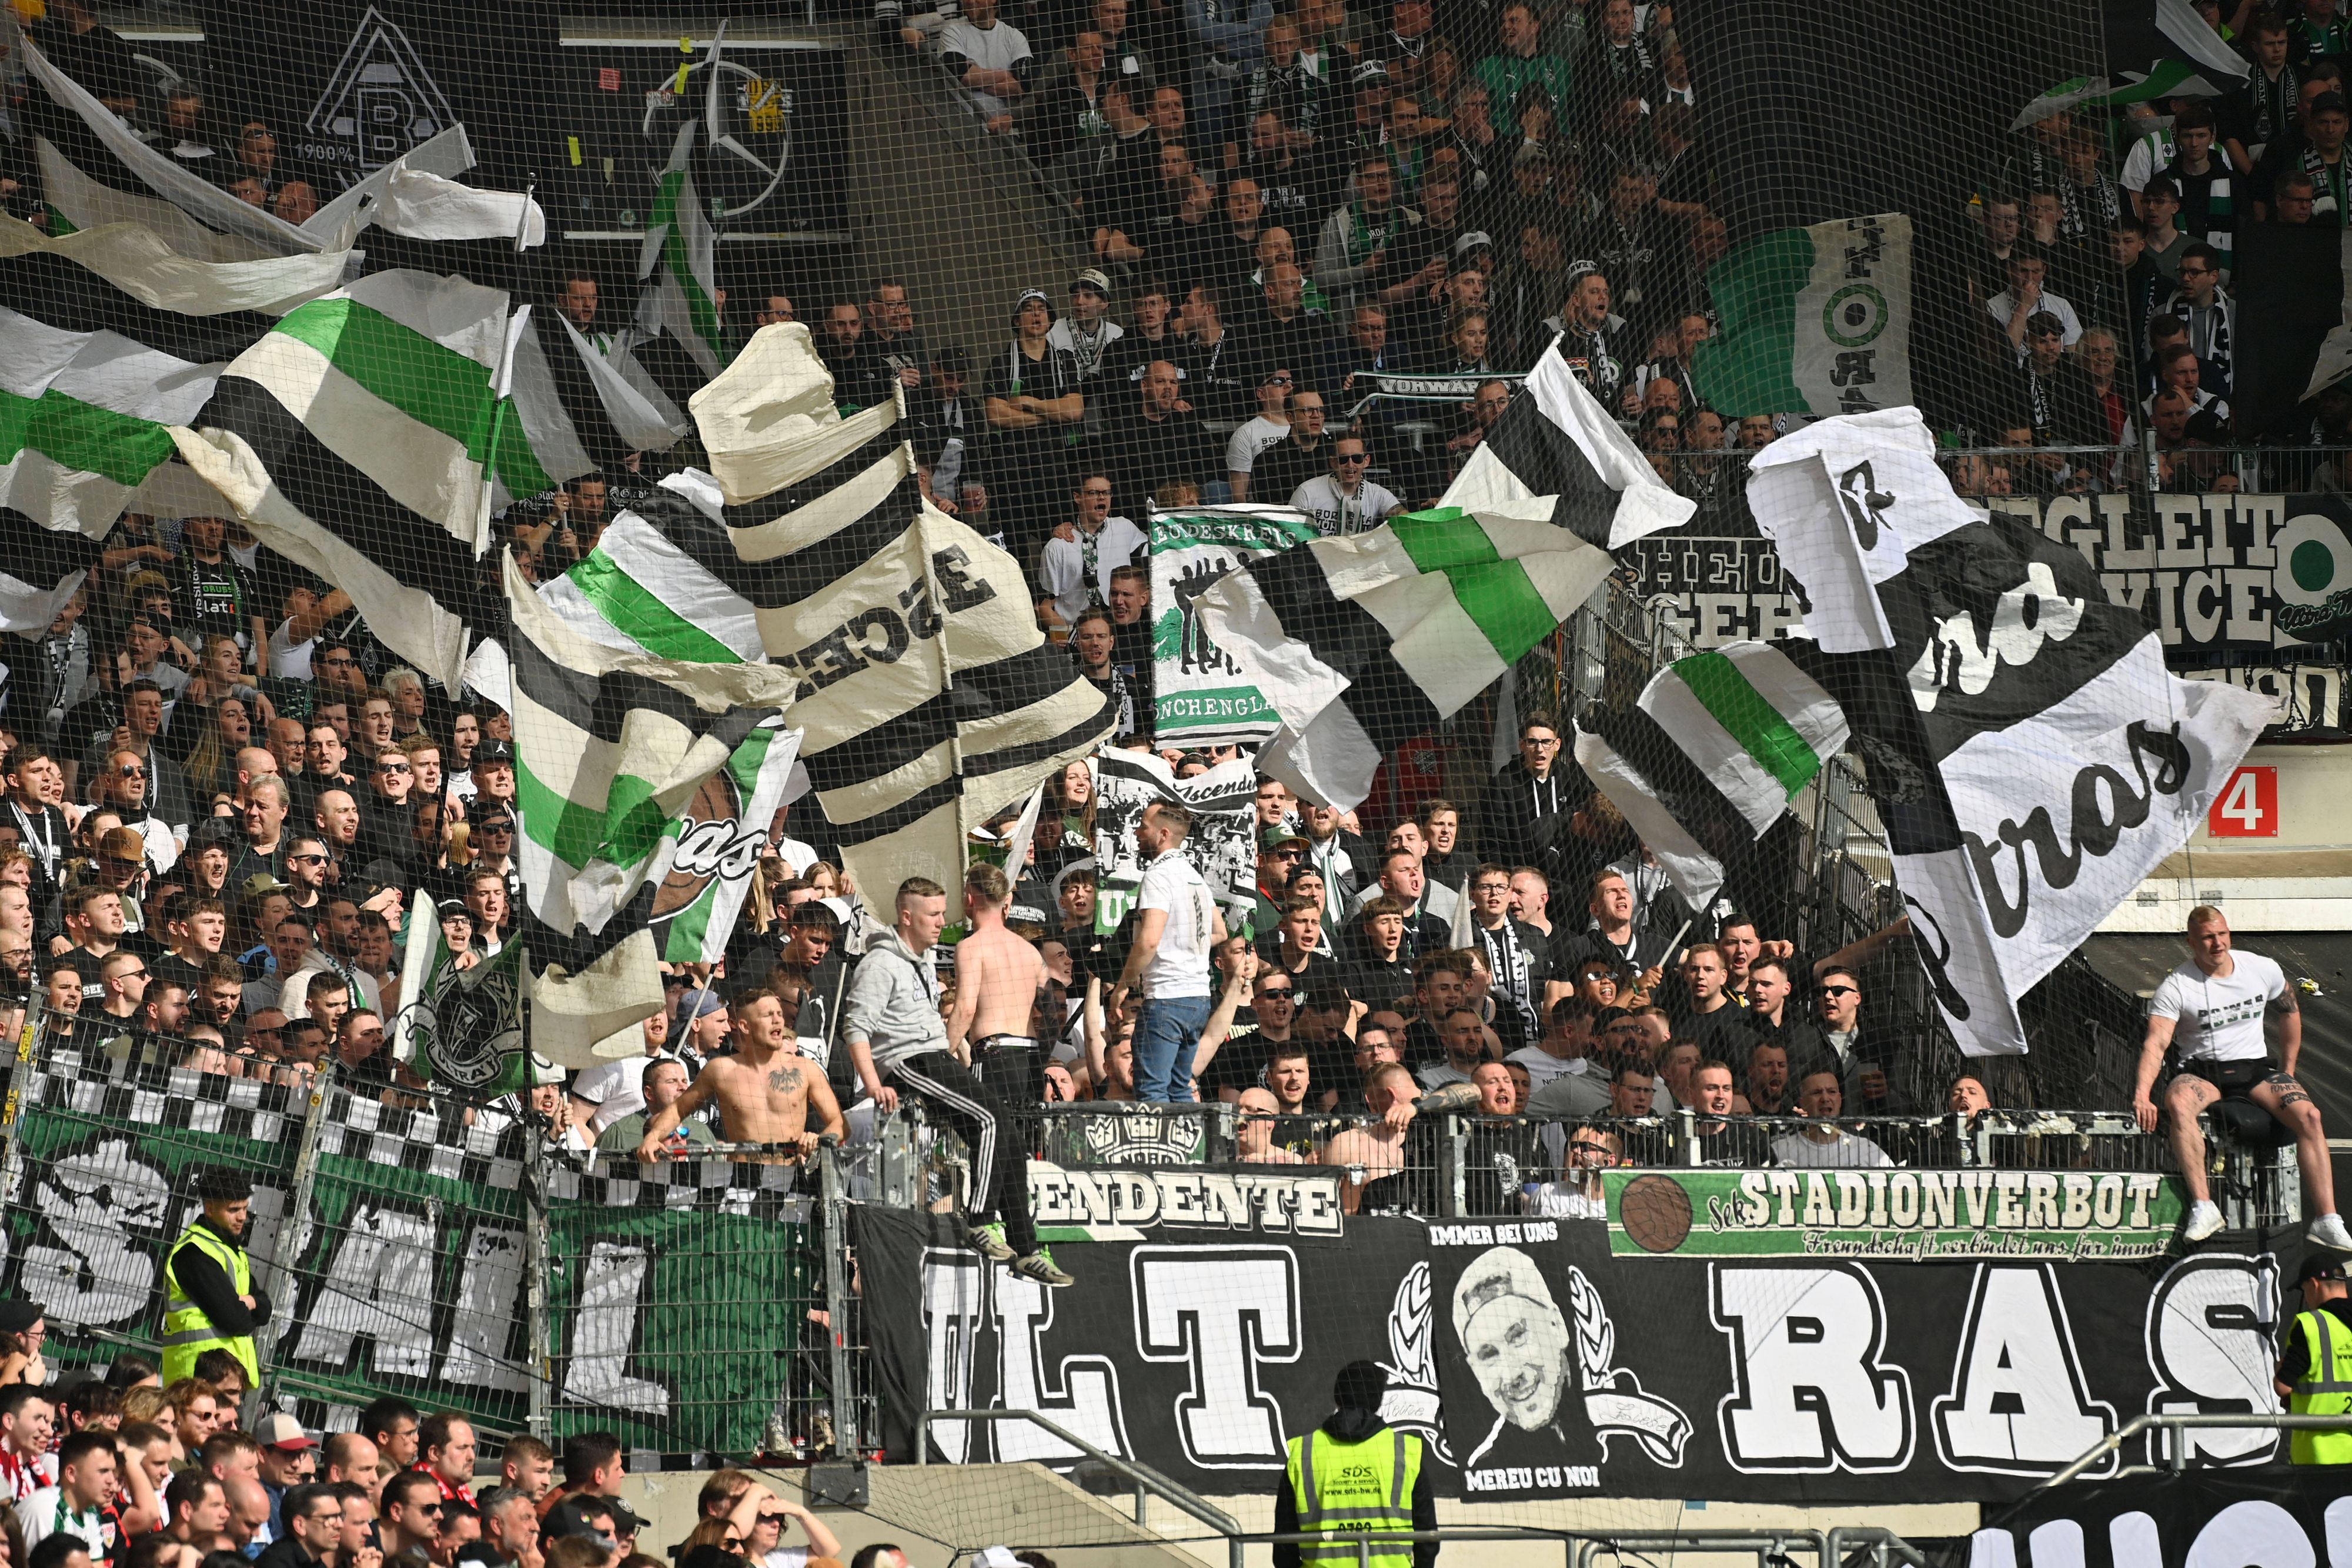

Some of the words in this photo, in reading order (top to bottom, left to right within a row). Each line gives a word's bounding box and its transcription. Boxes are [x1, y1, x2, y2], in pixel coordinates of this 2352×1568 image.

[295, 143, 355, 161] 1900%
[2221, 773, 2263, 830] 4
[1739, 1171, 2160, 1231] STADIONVERBOT
[1429, 1225, 1494, 1246] IMMER
[1495, 1223, 1522, 1244] BEI
[1523, 1222, 1559, 1242] UNS
[1341, 1466, 1372, 1478] SDS
[1465, 1467, 1532, 1492] MEREU
[1535, 1467, 1562, 1487] CU
[1563, 1466, 1601, 1487] NOI
